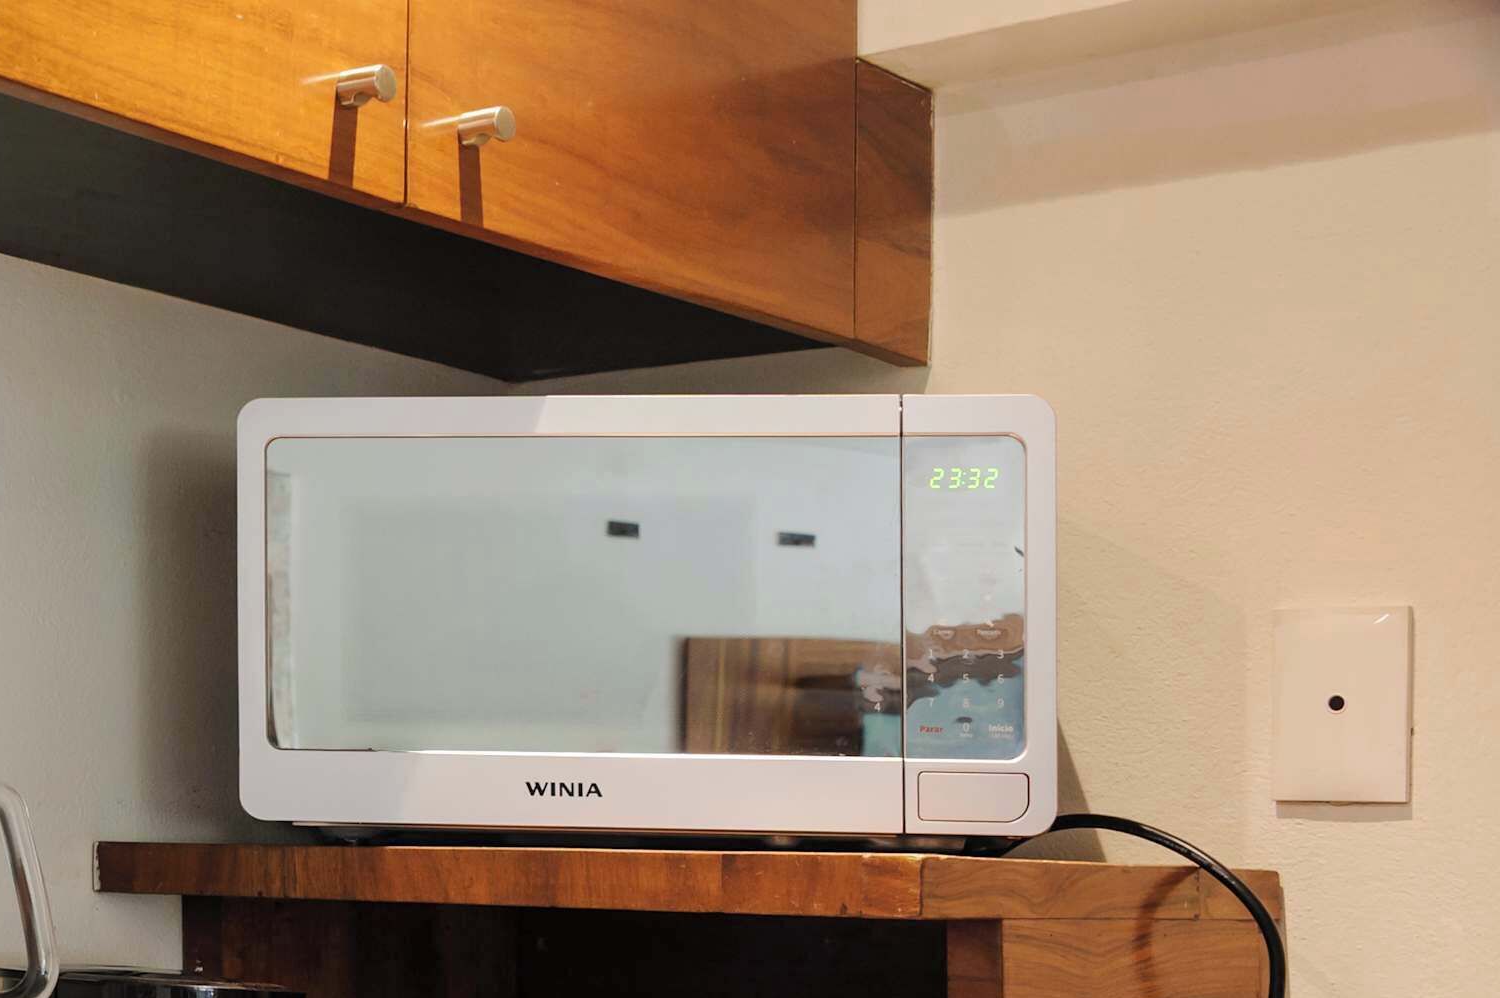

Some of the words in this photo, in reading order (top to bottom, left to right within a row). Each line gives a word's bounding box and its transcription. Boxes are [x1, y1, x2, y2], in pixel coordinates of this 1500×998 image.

[930, 467, 999, 489] 23:32
[962, 648, 970, 660] 2
[996, 648, 1005, 660] 3
[927, 673, 935, 683] 4
[962, 673, 970, 684] 5
[996, 673, 1005, 685] 6
[525, 781, 603, 798] WINIA
